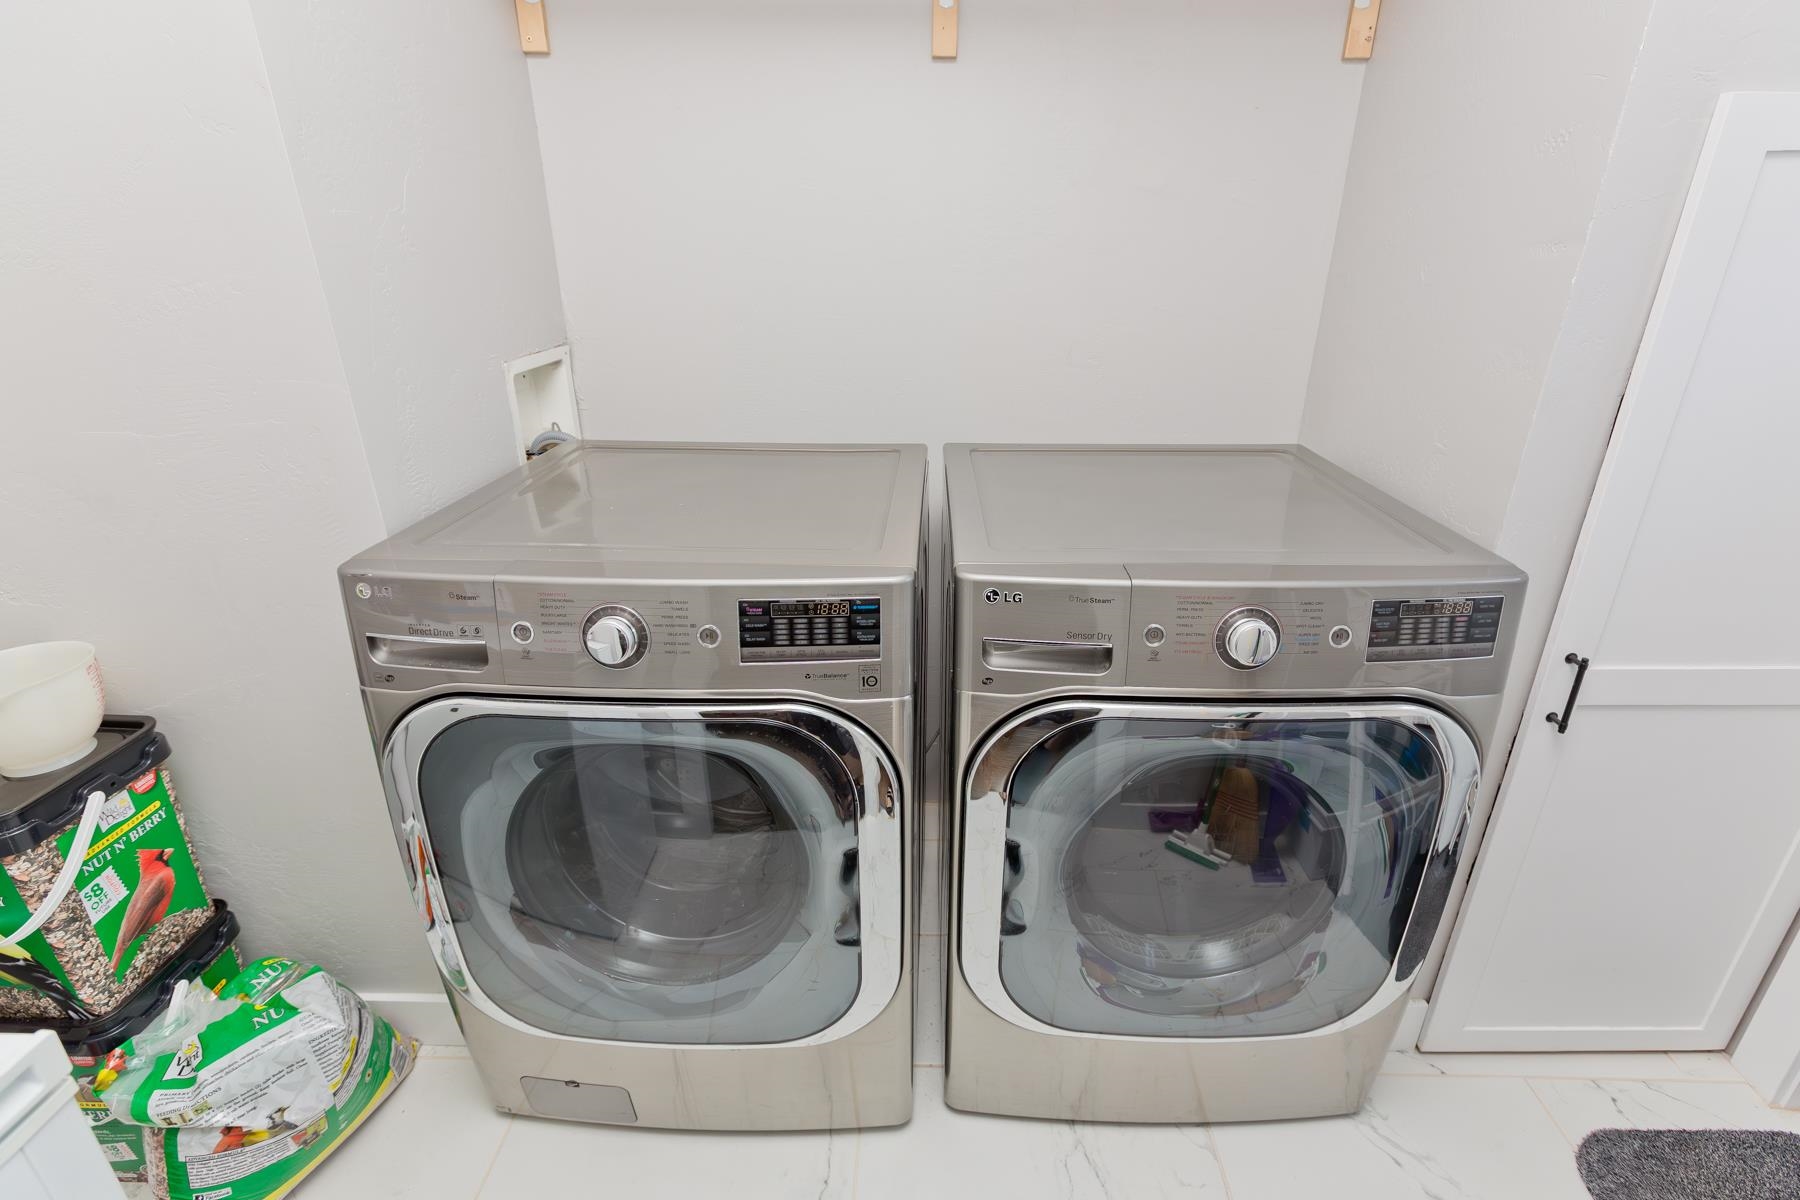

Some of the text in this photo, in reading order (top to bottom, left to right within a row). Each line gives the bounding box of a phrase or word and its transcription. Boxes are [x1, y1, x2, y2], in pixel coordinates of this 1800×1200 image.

[1003, 591, 1024, 603] LG
[408, 626, 455, 638] Direct Drive
[1066, 631, 1113, 641] Sensor Dry
[862, 675, 878, 687] 10
[81, 847, 112, 876] NUT
[129, 807, 168, 842] BERRY
[83, 883, 104, 901] $8
[91, 891, 109, 910] OFF
